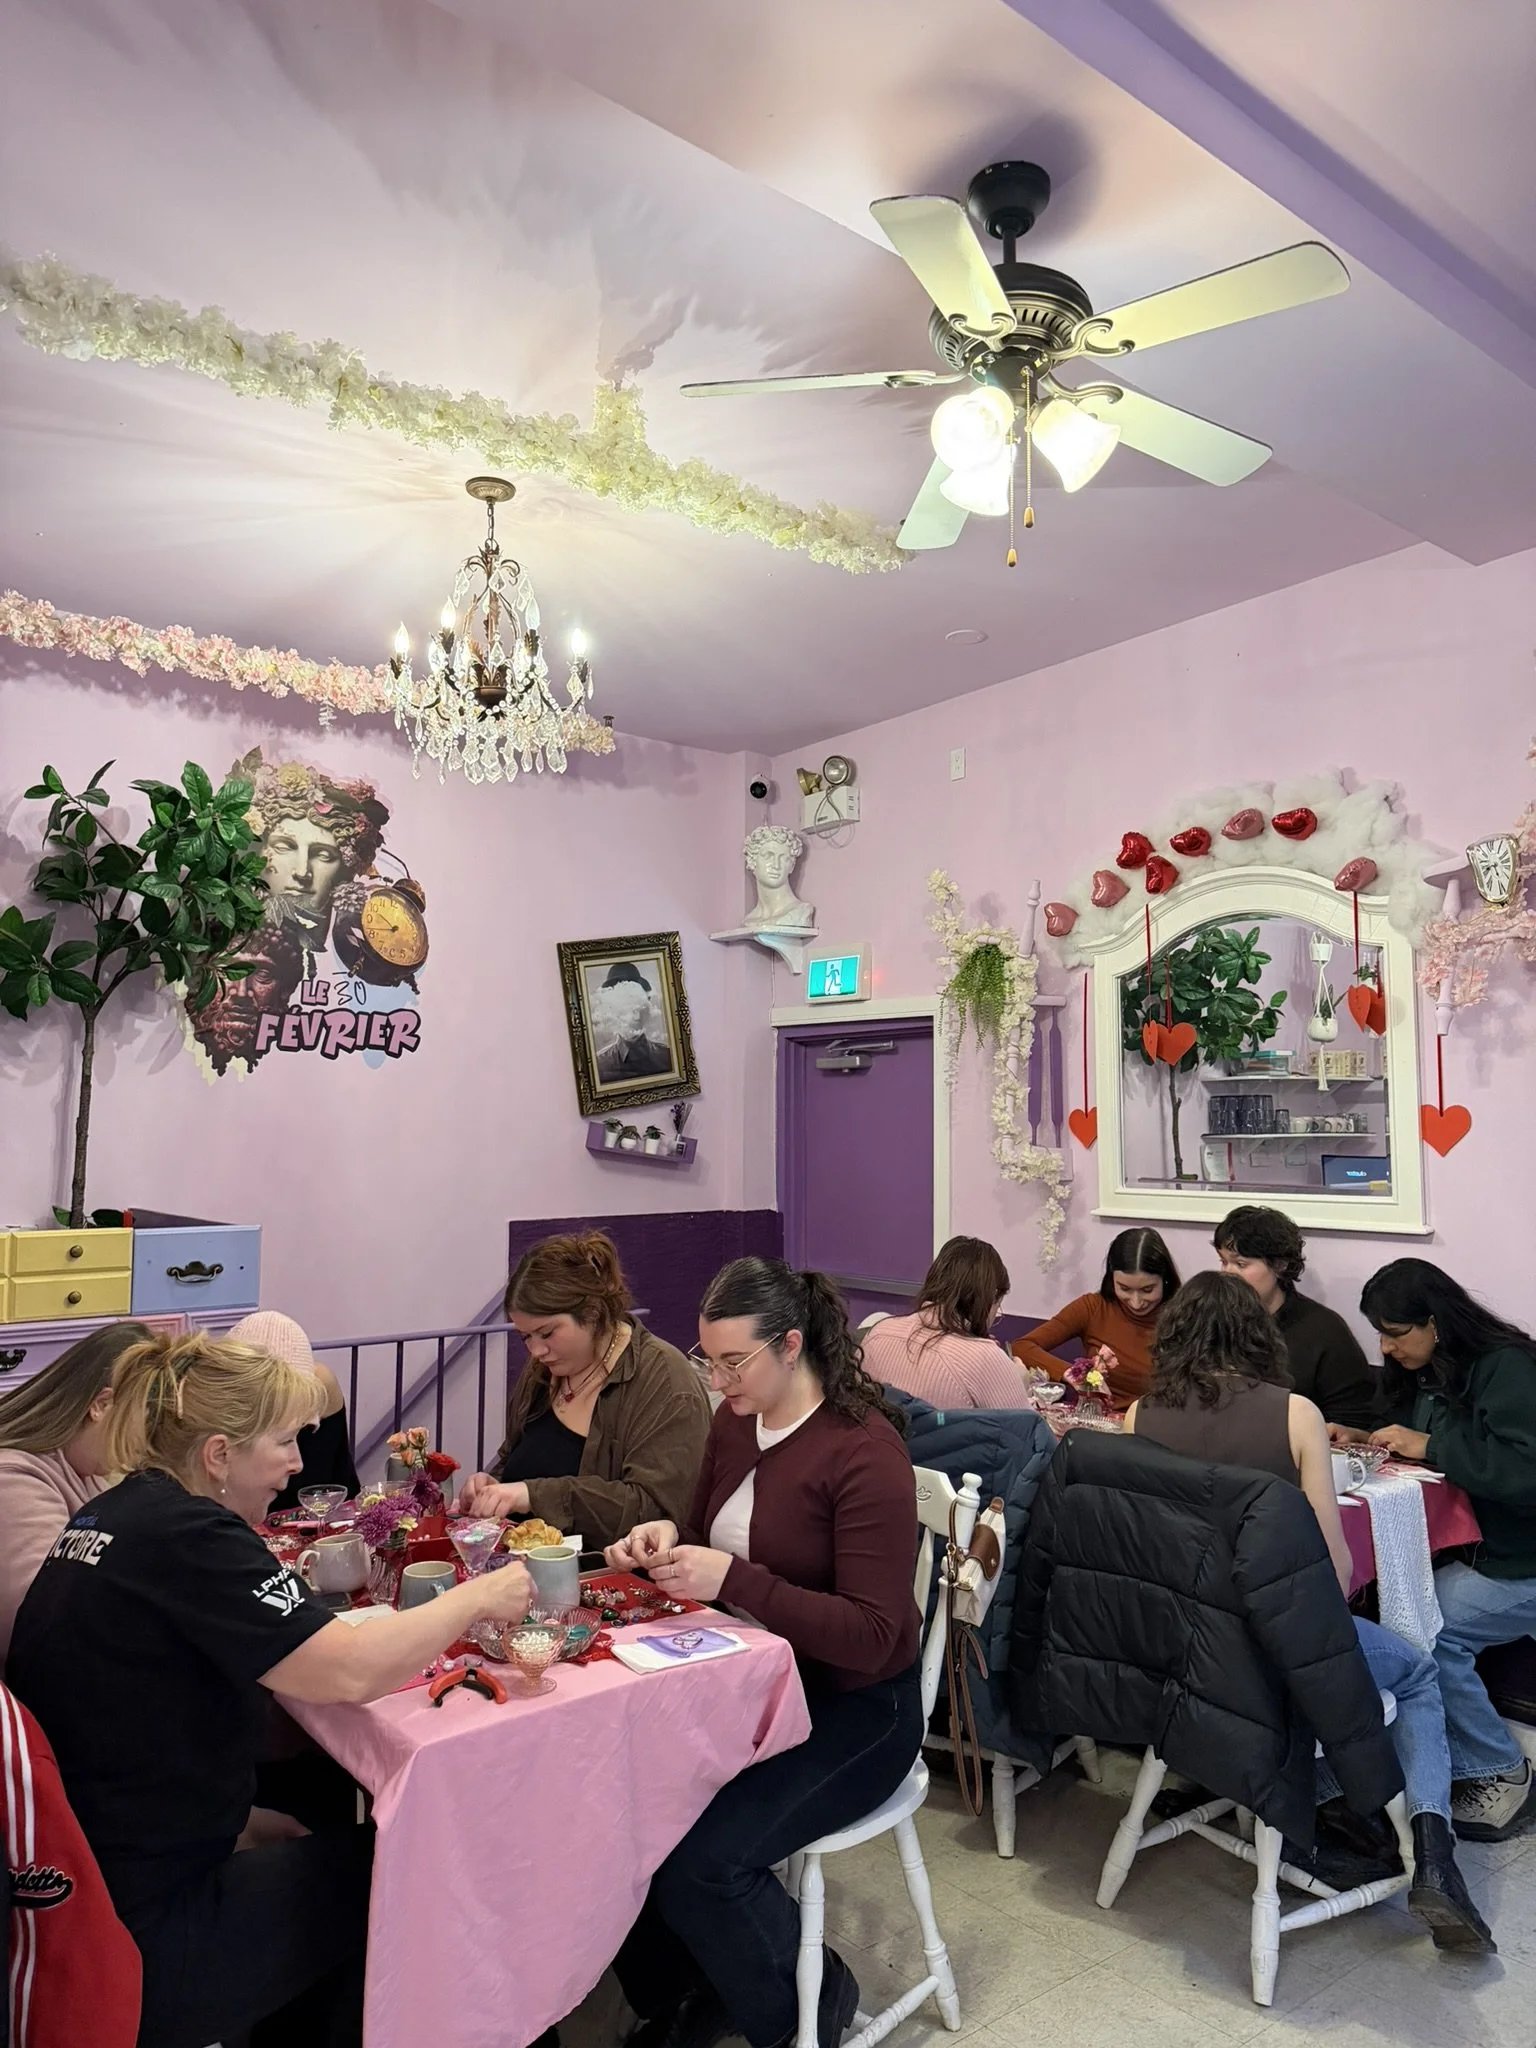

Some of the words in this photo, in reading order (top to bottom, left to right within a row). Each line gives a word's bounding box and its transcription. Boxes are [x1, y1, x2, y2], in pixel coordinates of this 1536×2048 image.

[370, 903, 379, 913] 10
[368, 929, 376, 939] 8
[378, 941, 385, 951] 7
[302, 980, 330, 1006] LE
[334, 981, 367, 1005] 30
[254, 1005, 421, 1060] FÉVRIER
[49, 1529, 114, 1566] ICTOIRE
